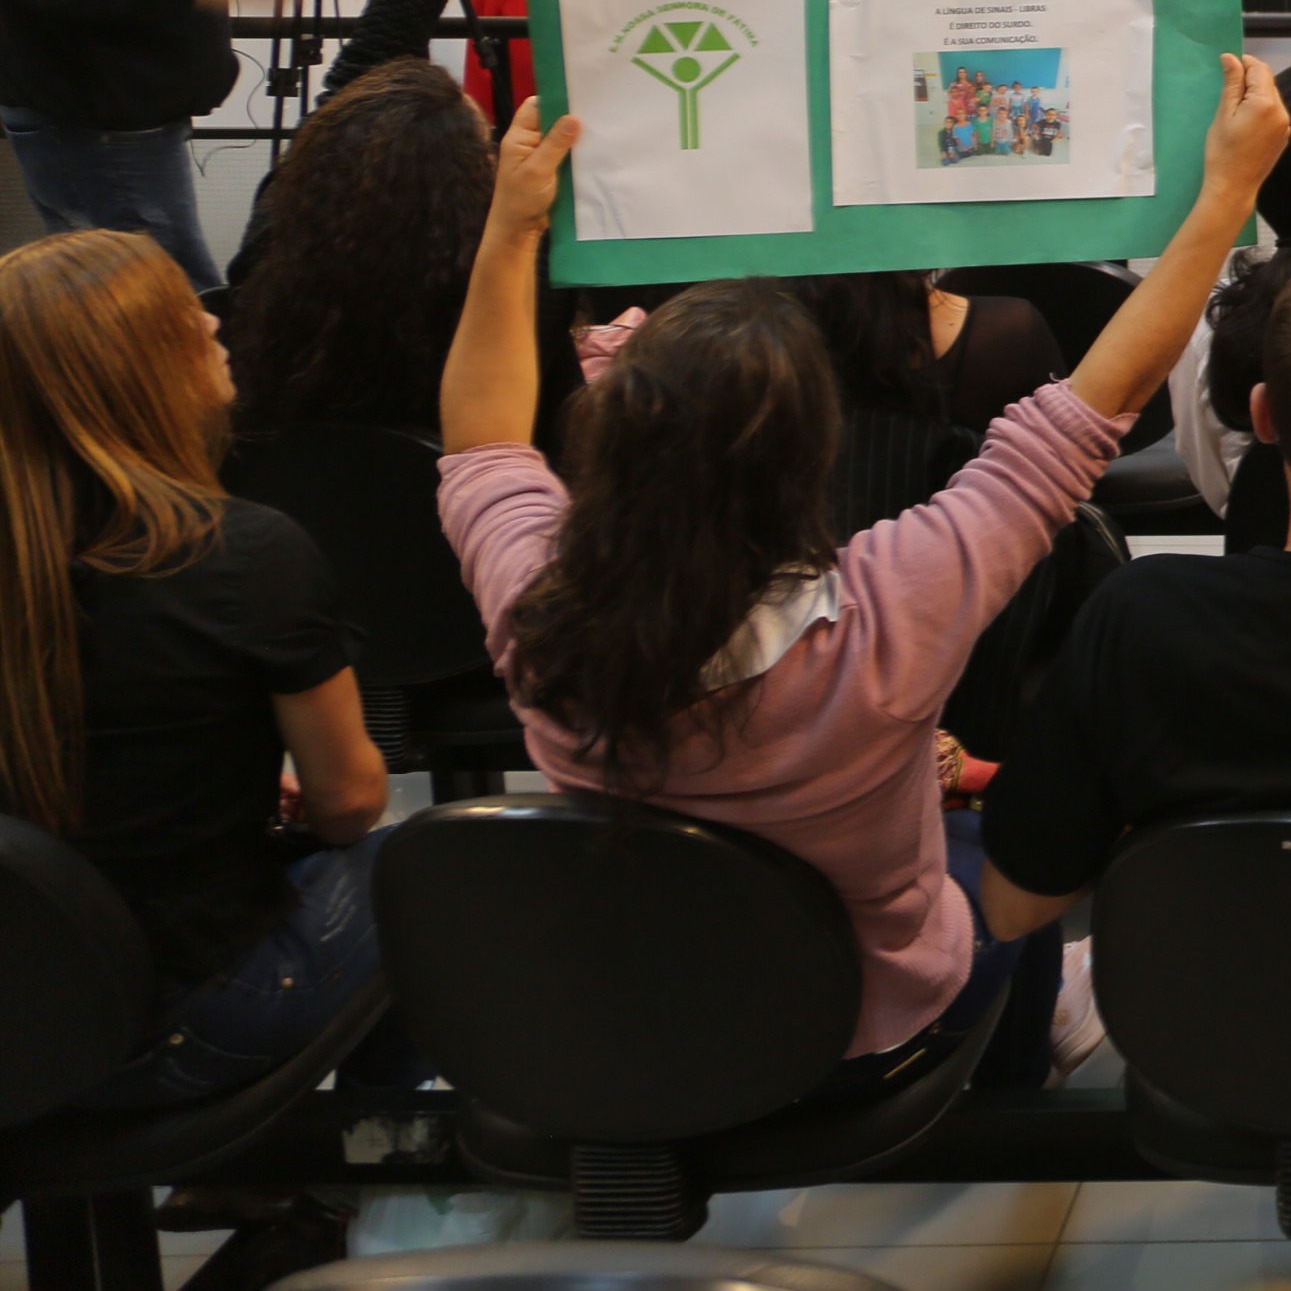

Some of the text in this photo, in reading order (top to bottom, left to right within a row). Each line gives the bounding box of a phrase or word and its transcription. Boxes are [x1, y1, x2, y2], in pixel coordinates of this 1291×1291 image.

[1018, 4, 1046, 13] LIBRAS
[989, 21, 1001, 29] DO
[957, 37, 974, 45] SUA
